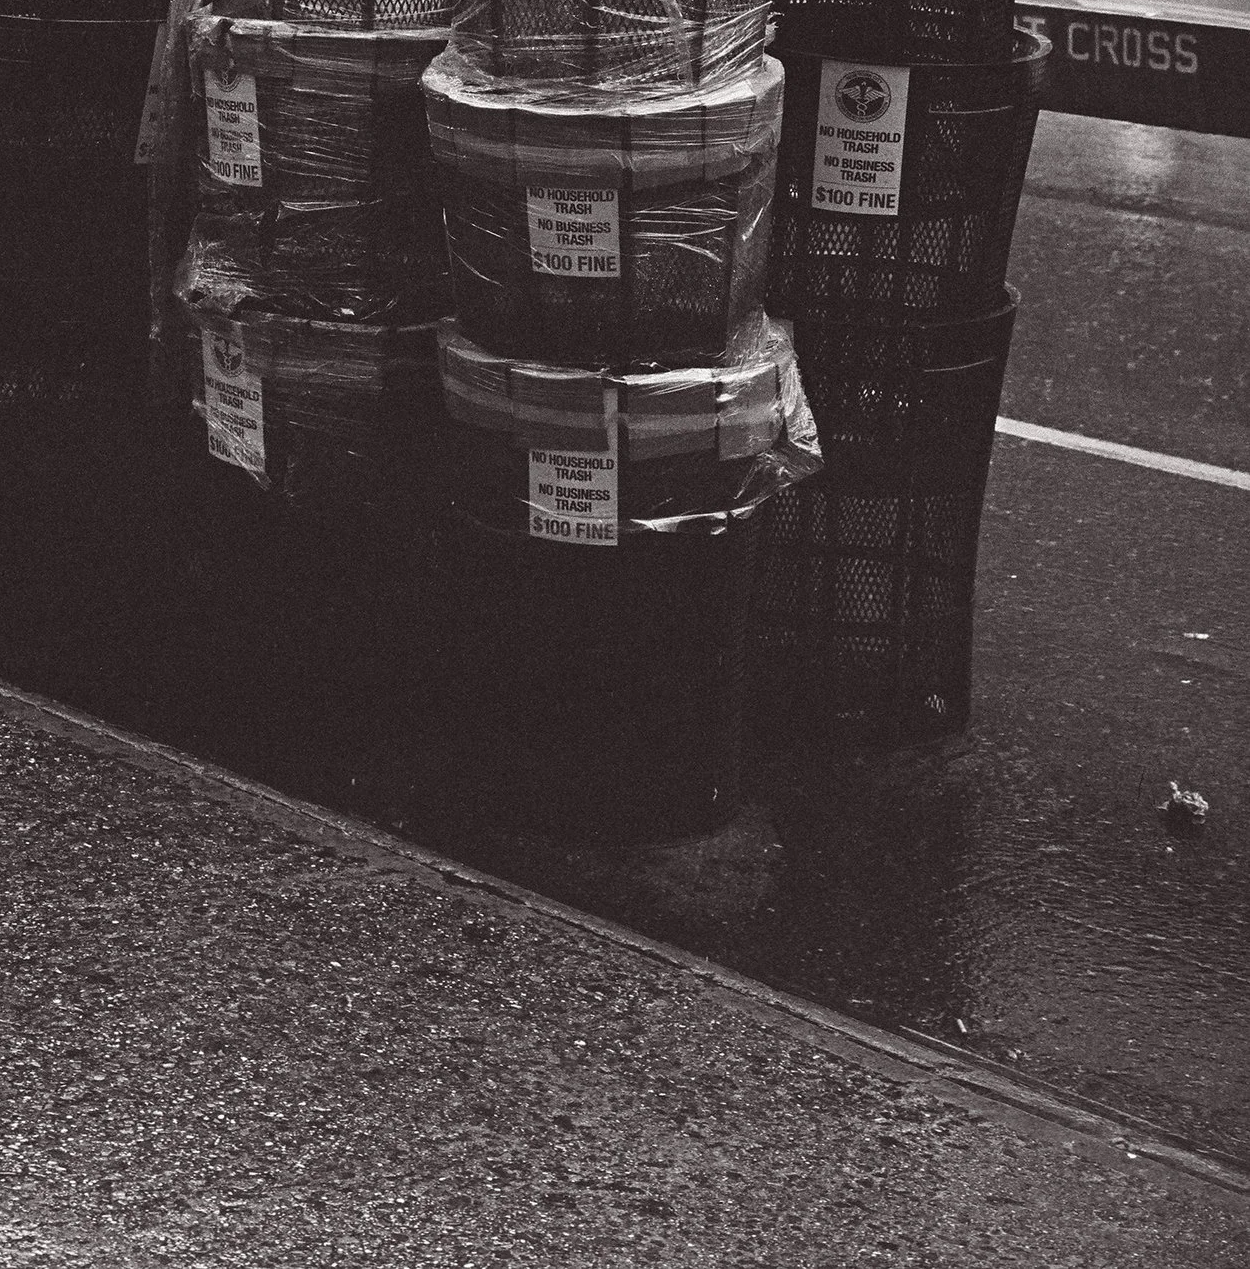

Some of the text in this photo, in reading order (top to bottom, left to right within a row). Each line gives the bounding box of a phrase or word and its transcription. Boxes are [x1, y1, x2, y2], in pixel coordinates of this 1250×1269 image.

[1068, 22, 1198, 74] CROSS
[215, 99, 254, 112] HOUSEHOLD
[219, 111, 240, 124] TRASH
[819, 125, 901, 143] NO HOUSEHOLD
[221, 140, 242, 152] TRASH
[842, 141, 879, 154] TRASH
[824, 155, 895, 173] NO BUSINESS
[234, 164, 259, 181] FINE
[840, 169, 877, 183] TRASH
[530, 188, 614, 202] NO HOUSEHOLD
[816, 186, 896, 209] $100 FINE
[554, 202, 592, 214] TRASH
[538, 218, 611, 233] NO BUSINESS
[555, 233, 593, 245] TRASH
[533, 252, 617, 271] $100 FINE
[531, 451, 614, 470] NO HOUSEHOLD
[555, 467, 592, 481] TRASH
[538, 483, 610, 501] NO BUSINESS
[555, 499, 592, 512] TRASH
[533, 515, 615, 539] $100 FINE
